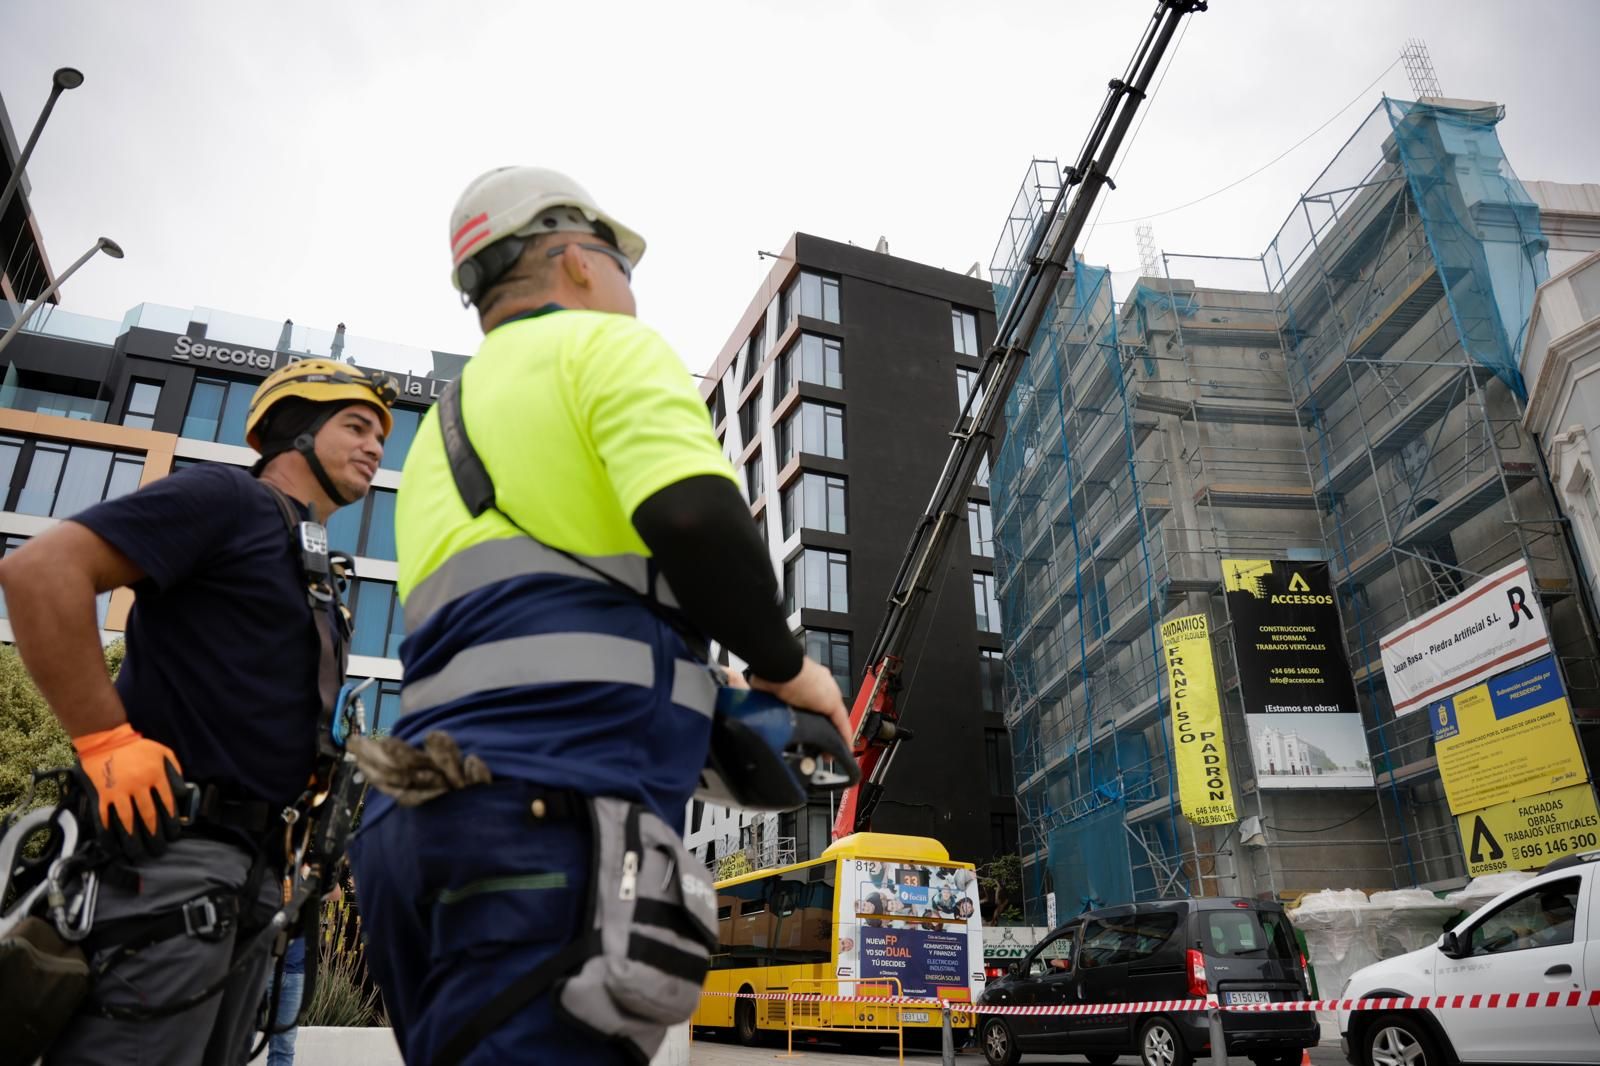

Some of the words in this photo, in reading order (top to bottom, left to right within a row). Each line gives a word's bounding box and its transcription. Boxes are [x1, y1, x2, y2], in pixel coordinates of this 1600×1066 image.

[173, 335, 278, 370] Sercotel
[1271, 594, 1333, 605] ACCESSOS
[1162, 615, 1206, 638] ANDAMIOS
[1259, 625, 1316, 633] CONSTRUCCIONES
[1184, 630, 1208, 640] ALQUILER
[1429, 637, 1453, 656] Piedra
[1453, 621, 1485, 644] Artificial
[1486, 612, 1502, 627] S.L.
[1256, 643, 1289, 651] TRABAJOS
[1290, 643, 1326, 651] VERTICALES
[1270, 676, 1325, 685] info@accessos.es
[1168, 646, 1196, 744] FRANCISCO
[1509, 683, 1543, 700] PRESIDENCIA
[1264, 704, 1302, 713] ¡Estamos
[1314, 704, 1340, 713] obras!
[1200, 731, 1225, 801] PADRÓN
[1518, 799, 1564, 817] FACHADAS
[1527, 813, 1557, 828] OBRAS
[1504, 827, 1544, 843] TRABAJOS
[1544, 815, 1598, 835] VERTICALES
[1520, 842, 1543, 859] 696
[1545, 838, 1568, 854] 146
[1570, 832, 1597, 849] 300
[855, 860, 876, 873] 812
[1471, 861, 1508, 874] accessos
[903, 874, 918, 887] 33
[866, 937, 886, 945] NUEVA
[886, 934, 898, 946] FP
[866, 948, 875, 956] YO
[875, 949, 887, 957] SOY
[886, 946, 912, 958] DUAL
[923, 943, 962, 951] ADMINISTRACIÓN
[872, 958, 880, 967] TÚ
[881, 960, 906, 968] DECIDES
[1438, 962, 1493, 975] STEPWAY
[1231, 993, 1253, 1003] 5150
